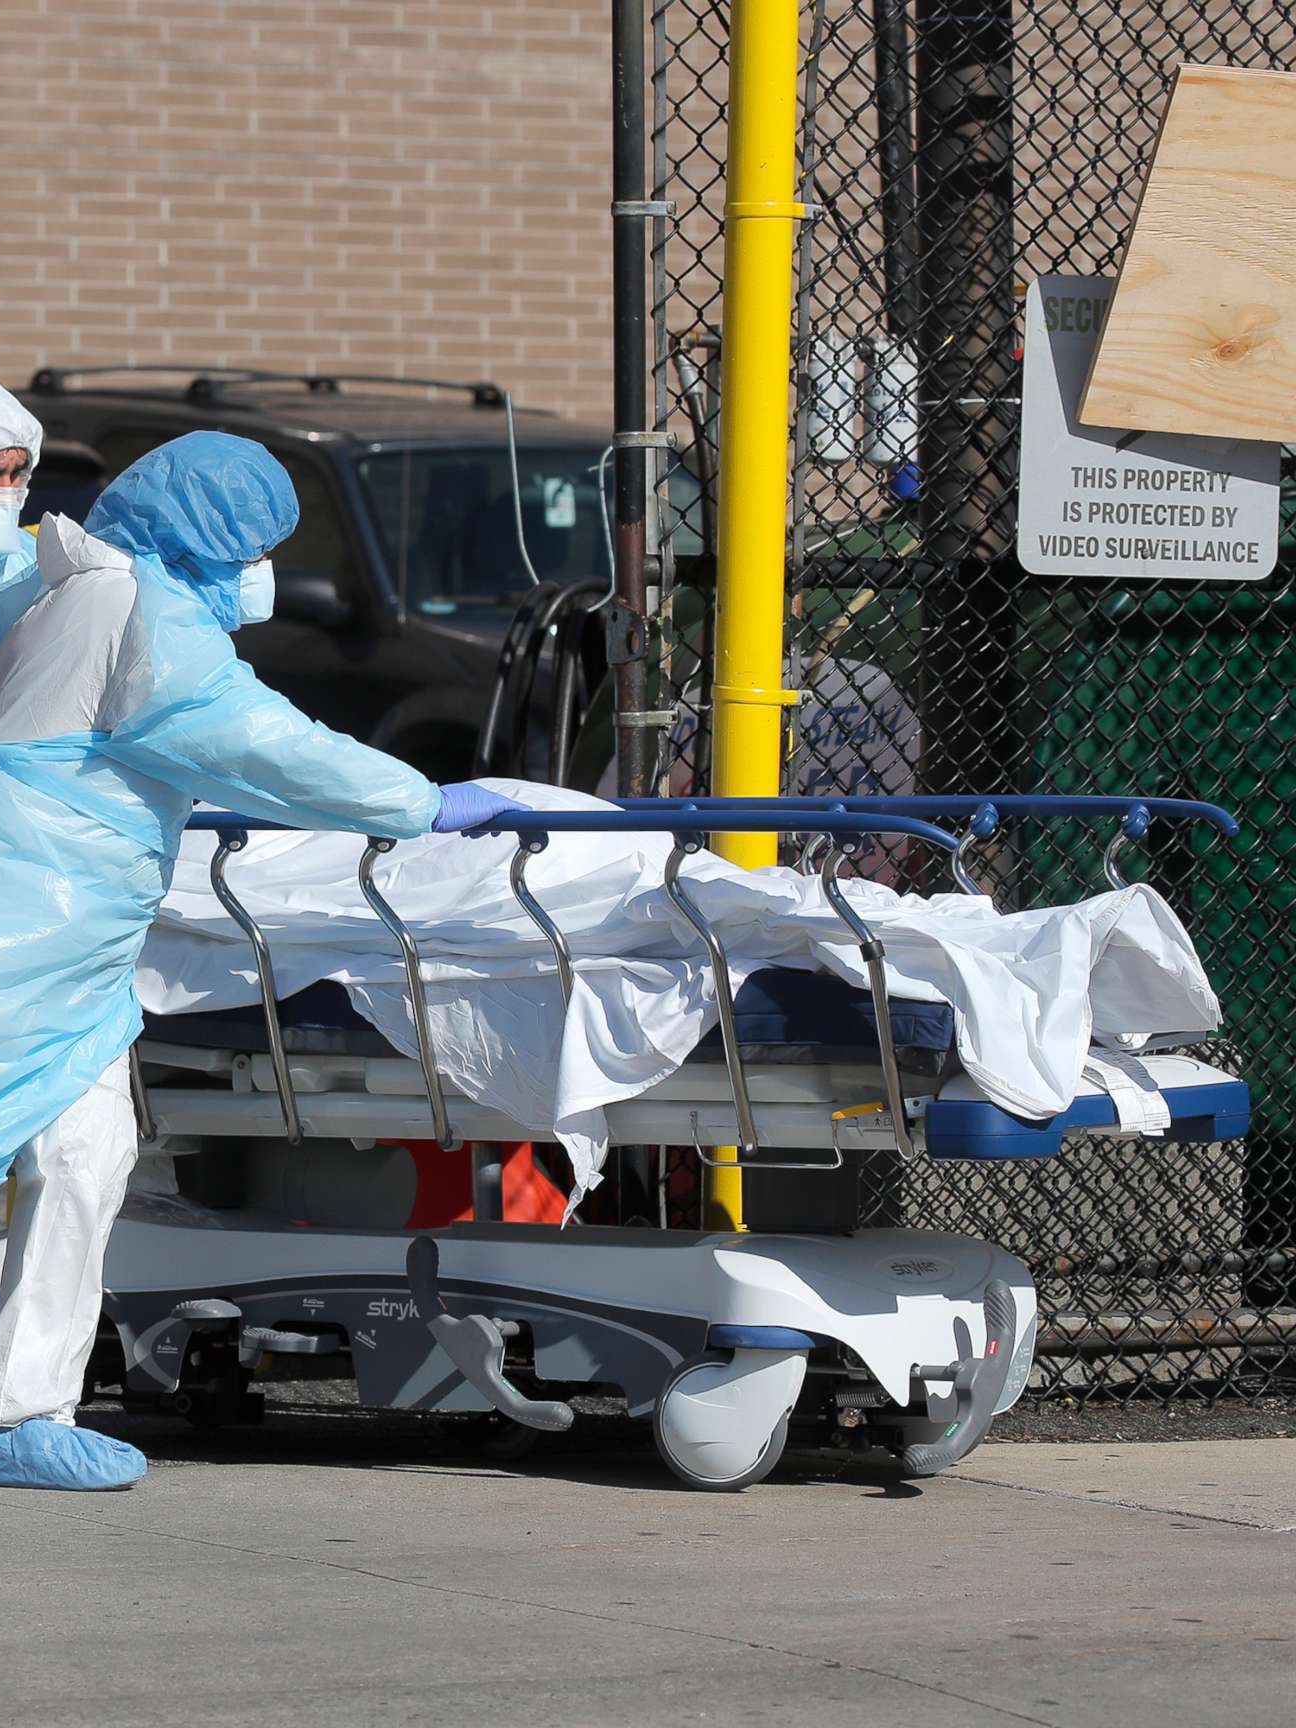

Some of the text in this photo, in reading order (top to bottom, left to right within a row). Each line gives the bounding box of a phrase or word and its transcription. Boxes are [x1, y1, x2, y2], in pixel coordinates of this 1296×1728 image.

[1071, 467, 1232, 493] THIS PROPERTY
[1062, 501, 1239, 528] IS PROTECTED BY
[1038, 535, 1260, 563] VIDEO SURVEILLANCE
